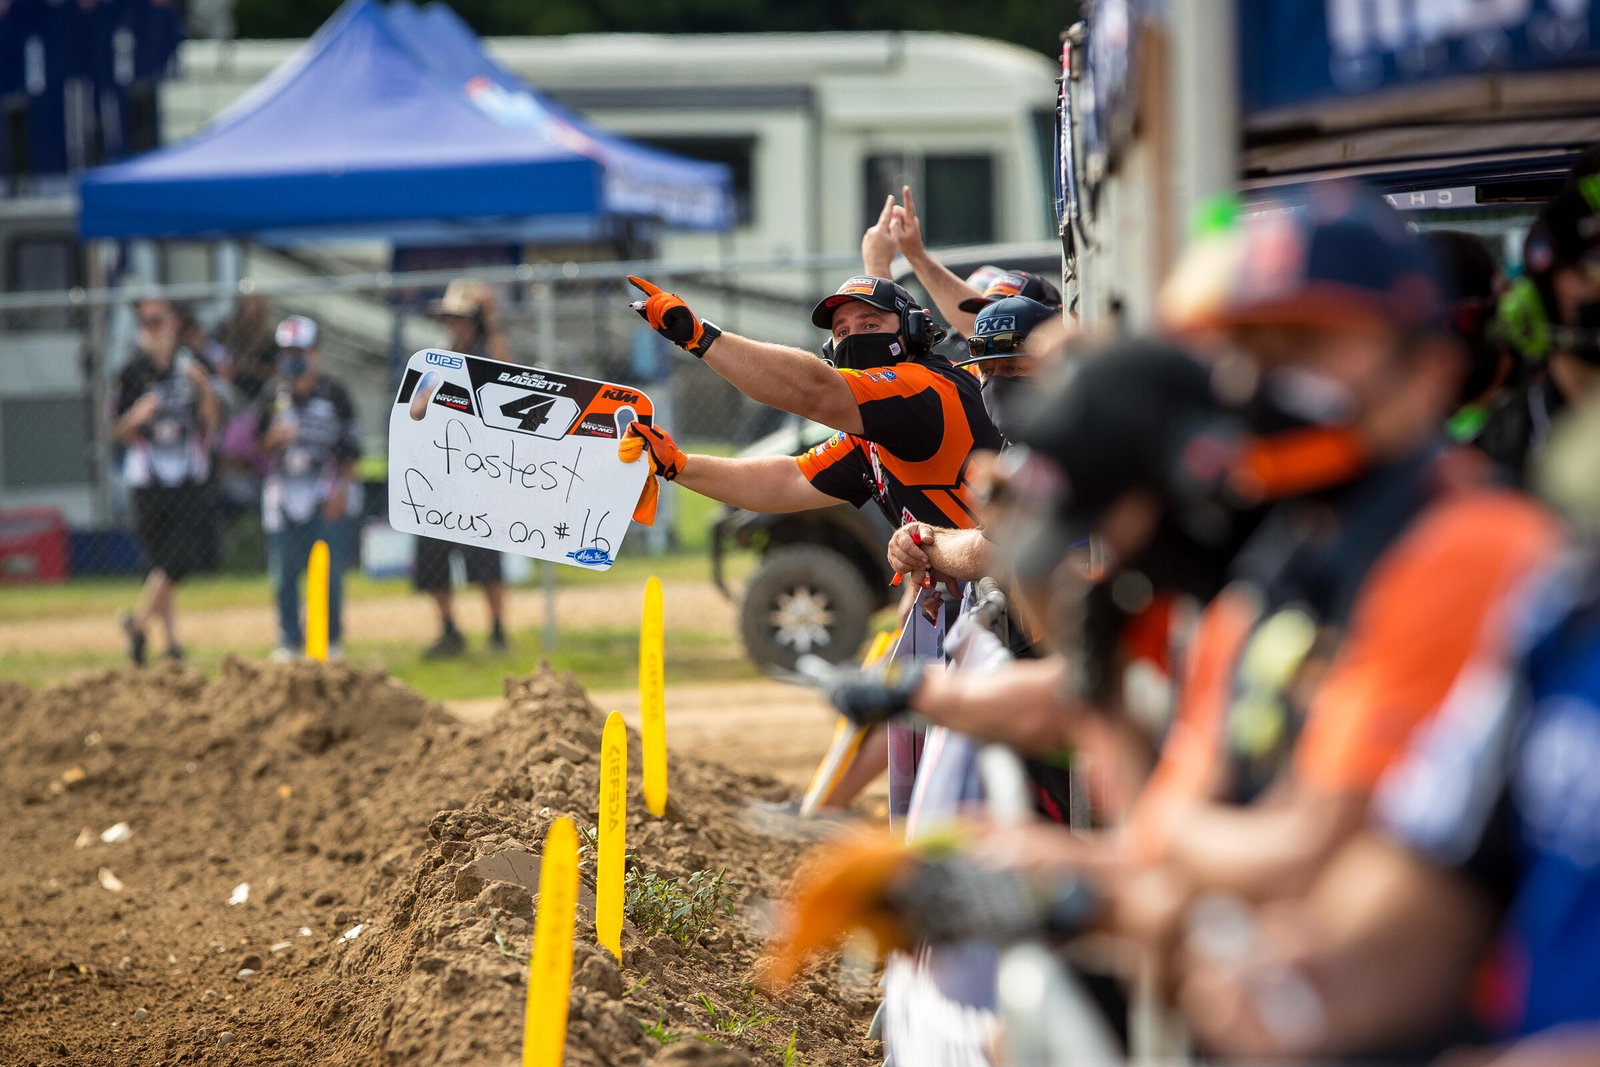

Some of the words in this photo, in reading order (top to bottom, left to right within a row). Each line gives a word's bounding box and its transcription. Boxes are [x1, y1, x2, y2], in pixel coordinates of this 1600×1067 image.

[976, 315, 1015, 333] FXR
[426, 352, 464, 370] WPS
[497, 372, 567, 392] BAGGETT
[601, 389, 639, 405] KTM
[499, 393, 557, 432] 4
[433, 418, 585, 503] fastest
[401, 467, 492, 537] focus
